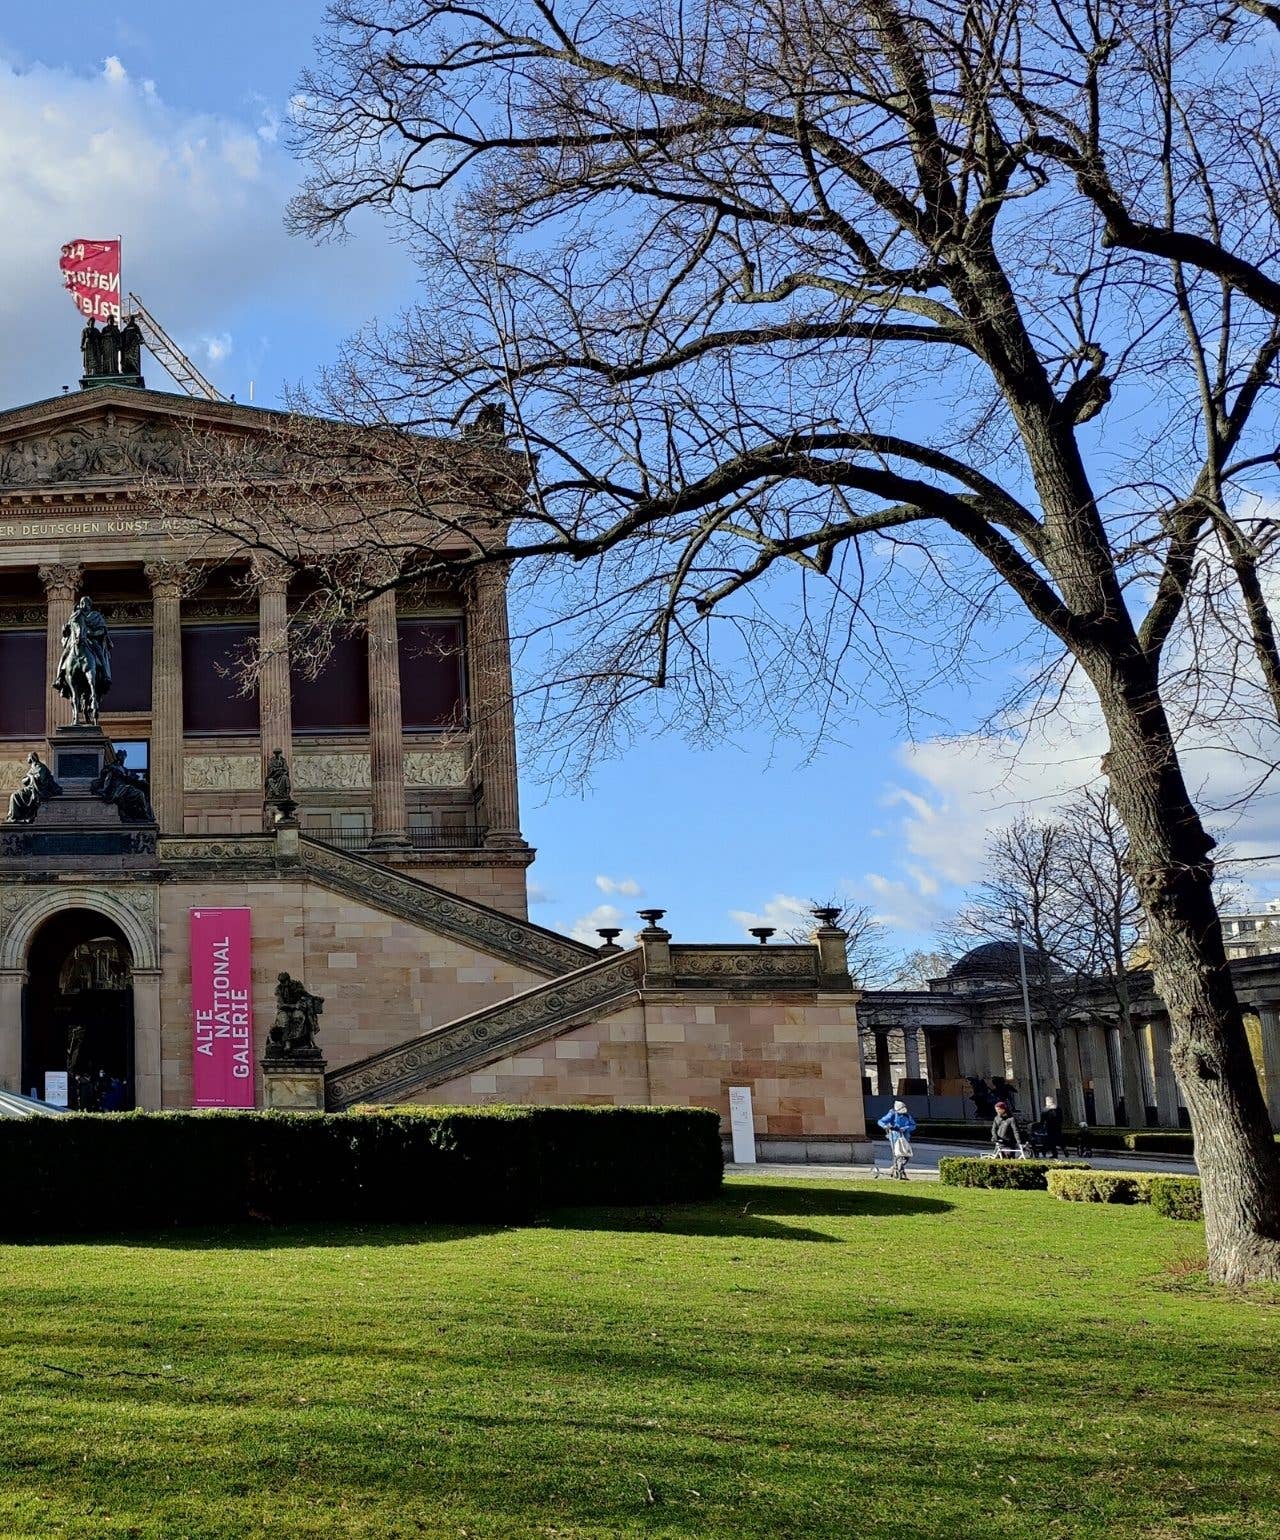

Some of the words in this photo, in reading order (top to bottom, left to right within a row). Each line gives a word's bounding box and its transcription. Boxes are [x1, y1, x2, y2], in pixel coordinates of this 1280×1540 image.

[22, 522, 100, 535] DEUTSCHEN
[107, 520, 150, 532] KUNST
[213, 936, 230, 1038] NATIONAL
[196, 1009, 213, 1056] ALTE
[231, 989, 250, 1078] GALERIE
